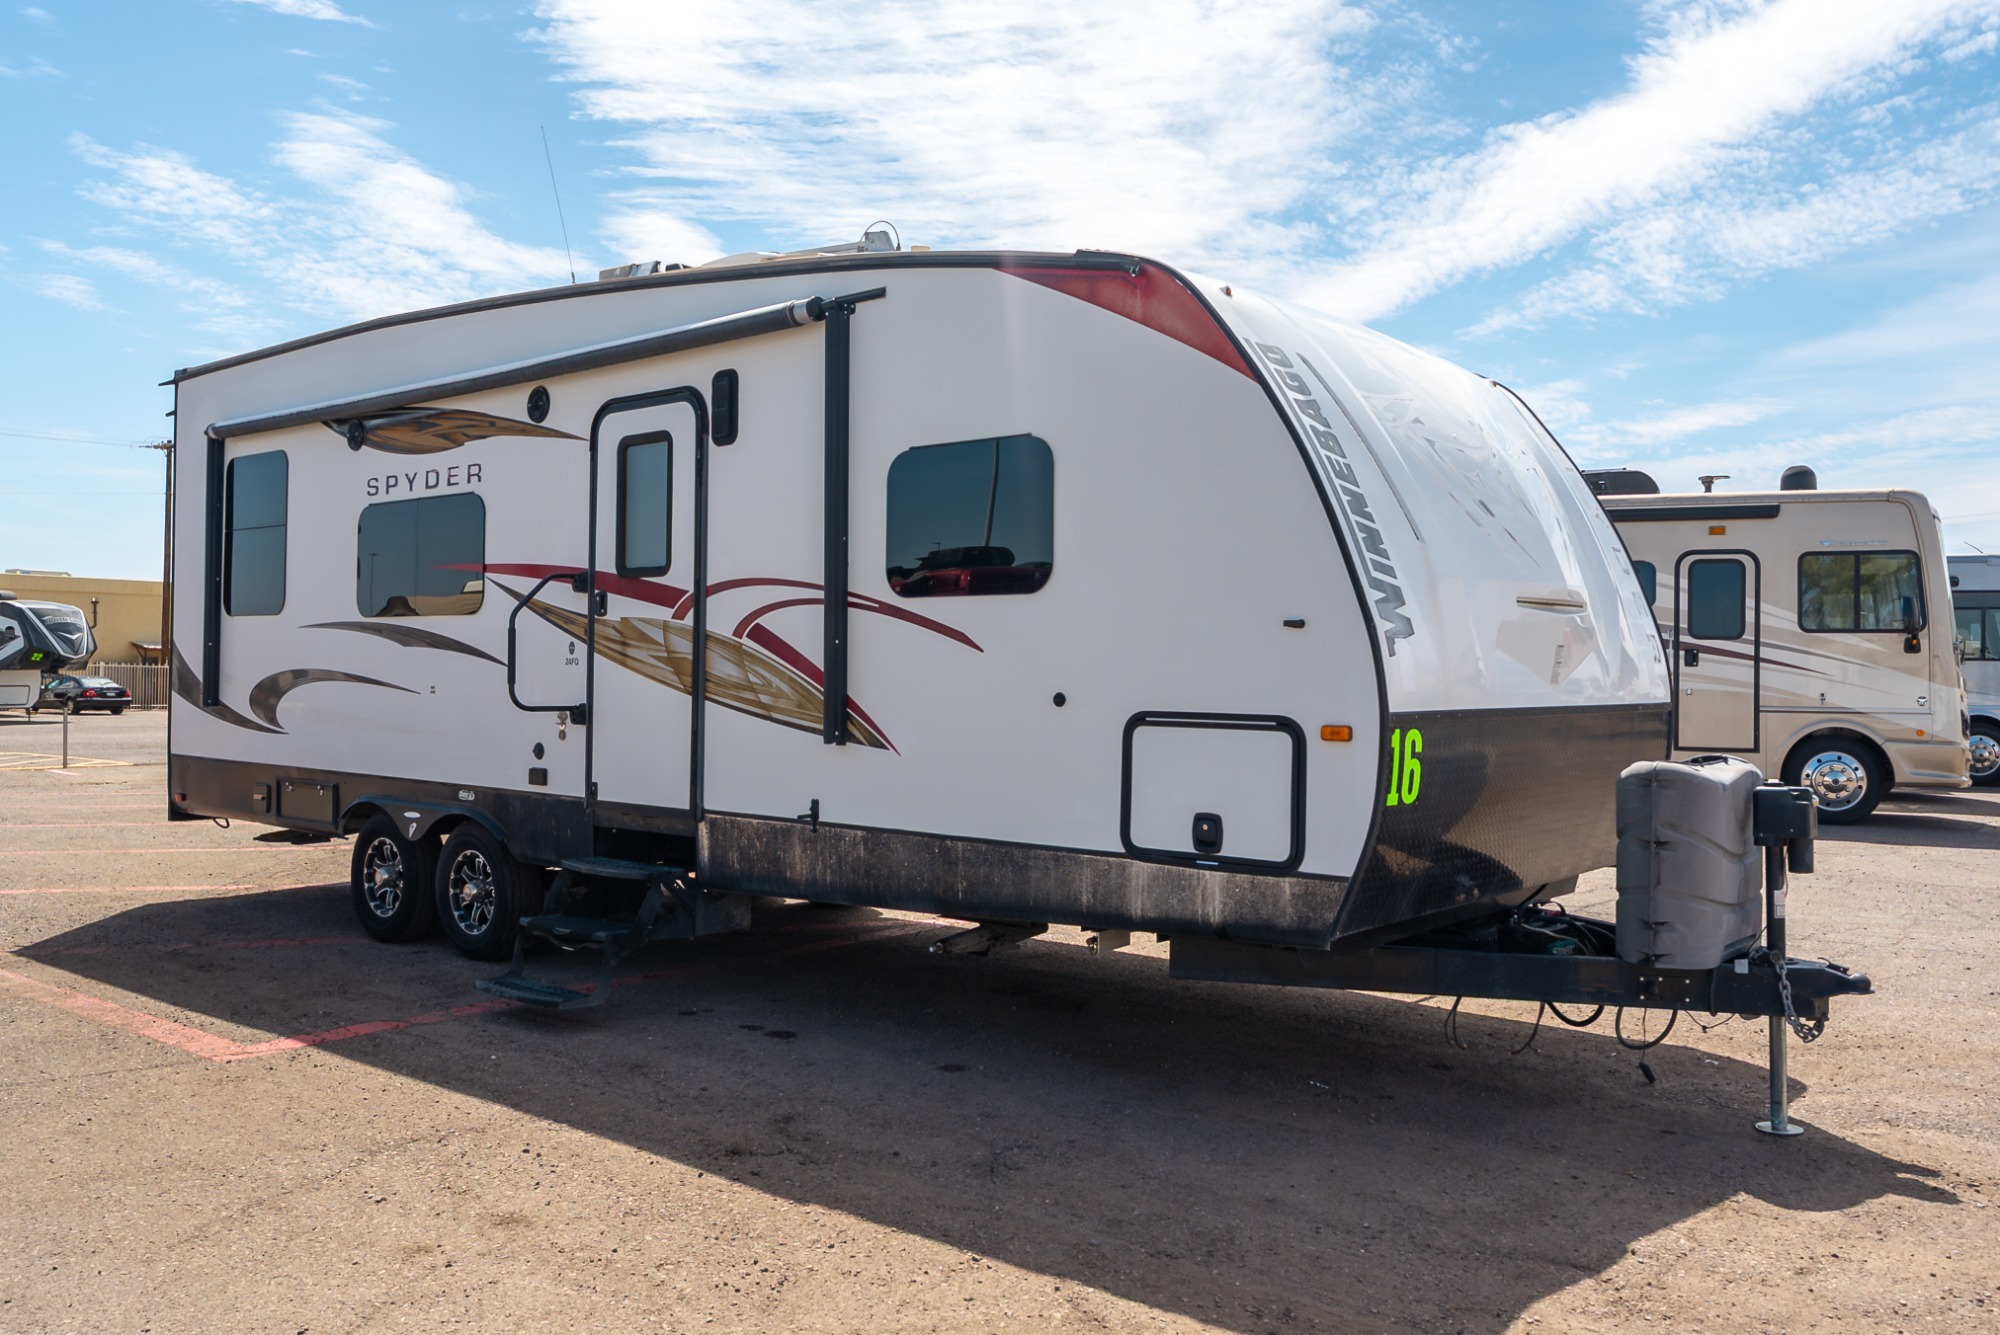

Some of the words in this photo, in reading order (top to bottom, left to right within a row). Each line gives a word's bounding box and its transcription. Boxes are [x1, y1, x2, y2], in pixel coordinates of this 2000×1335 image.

[366, 463, 482, 496] SPYDER
[1254, 340, 1415, 658] WINNEBAGO
[1386, 728, 1423, 806] 16
